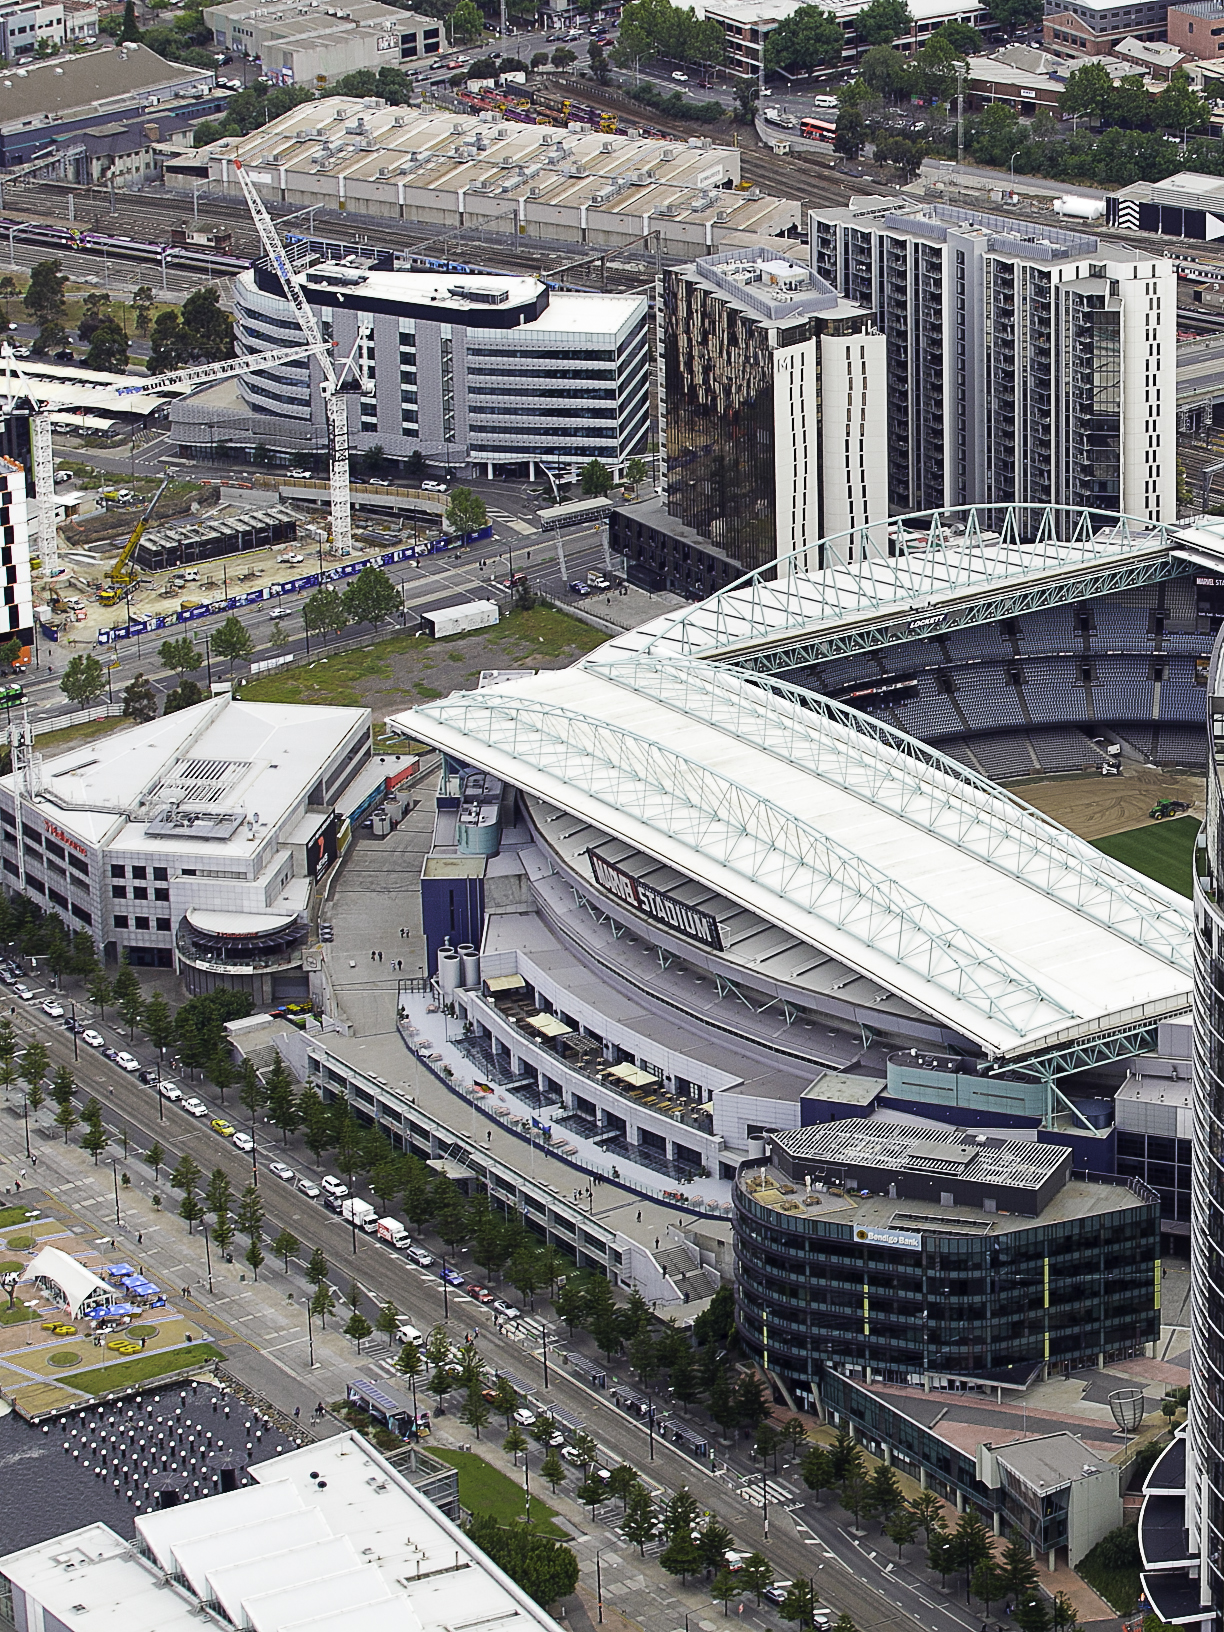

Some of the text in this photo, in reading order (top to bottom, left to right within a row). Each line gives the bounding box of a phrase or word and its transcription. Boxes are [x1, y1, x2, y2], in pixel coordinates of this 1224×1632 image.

[1196, 577, 1214, 586] MARVEL
[593, 856, 712, 942] MARVEL STADIUM
[867, 1232, 919, 1247] Bendigo Bank
